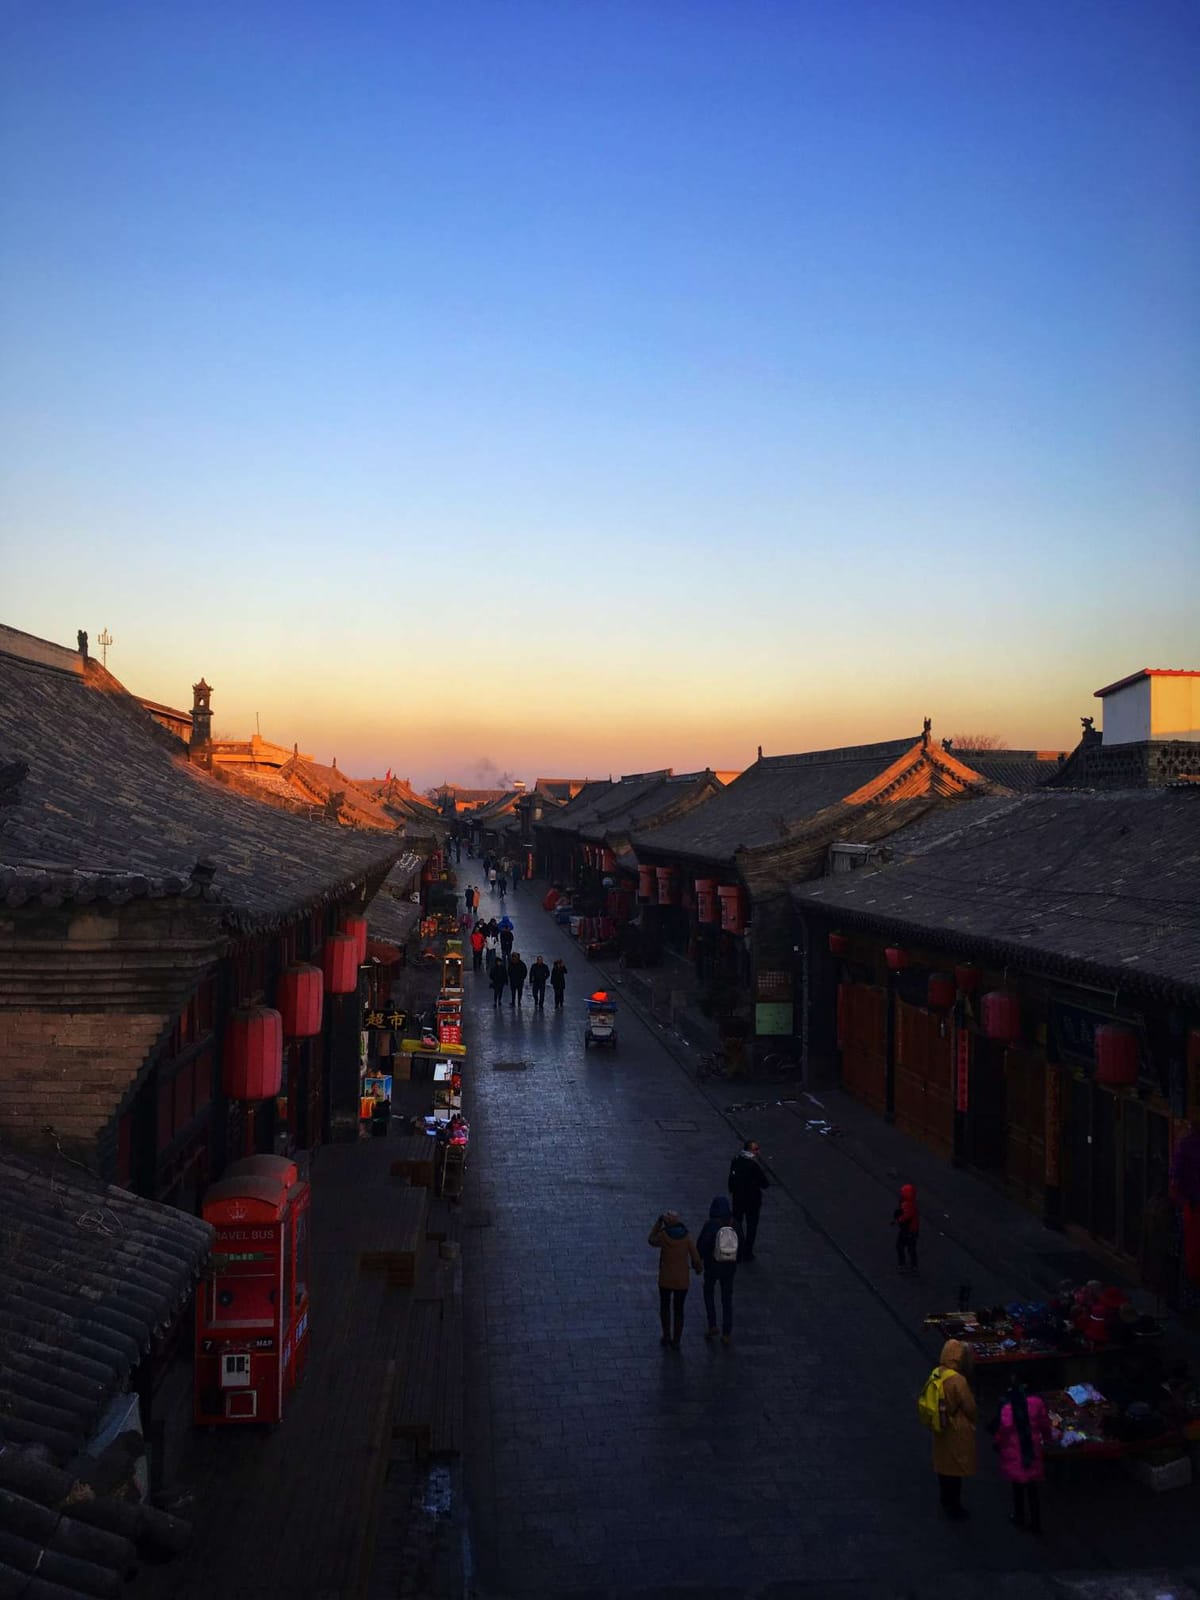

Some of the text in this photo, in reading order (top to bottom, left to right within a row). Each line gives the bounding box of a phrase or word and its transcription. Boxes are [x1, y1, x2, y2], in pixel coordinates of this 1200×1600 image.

[365, 1010, 406, 1031] 超市
[215, 1230, 274, 1241] RAVEL BUS
